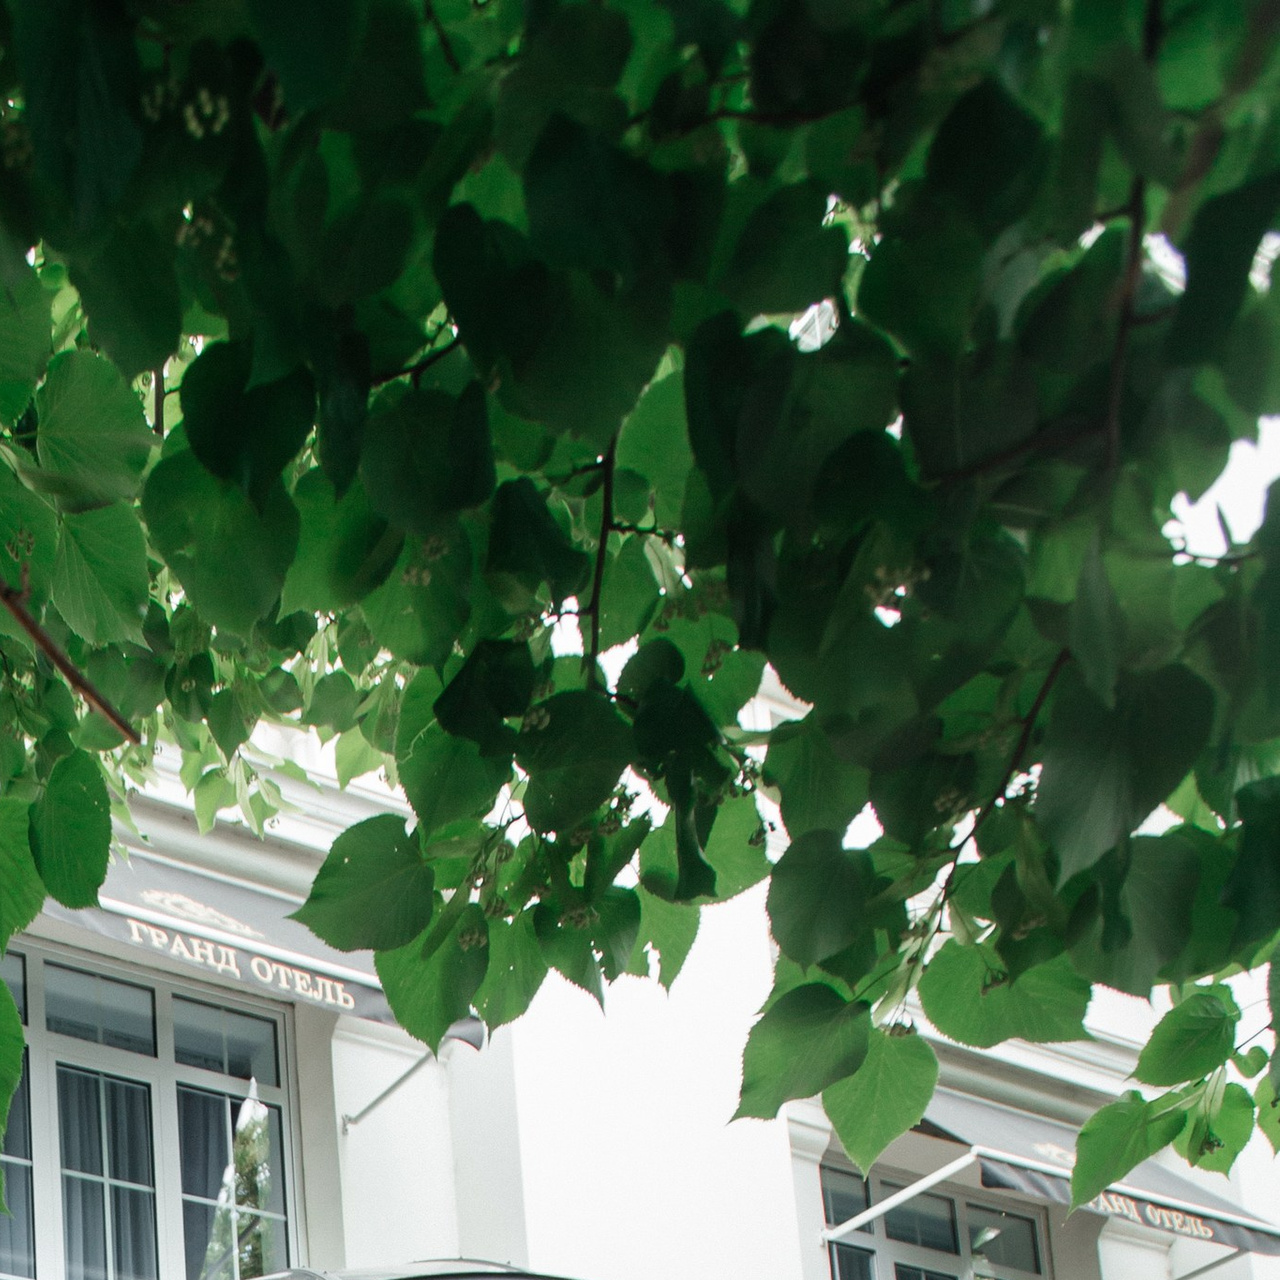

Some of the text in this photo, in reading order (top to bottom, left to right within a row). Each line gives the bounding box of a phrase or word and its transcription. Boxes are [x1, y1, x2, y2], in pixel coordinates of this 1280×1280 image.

[126, 918, 356, 1009] ГРАНД ОТЕЛЬ
[1087, 1191, 1214, 1239] АНД ОТЕЛЬ
